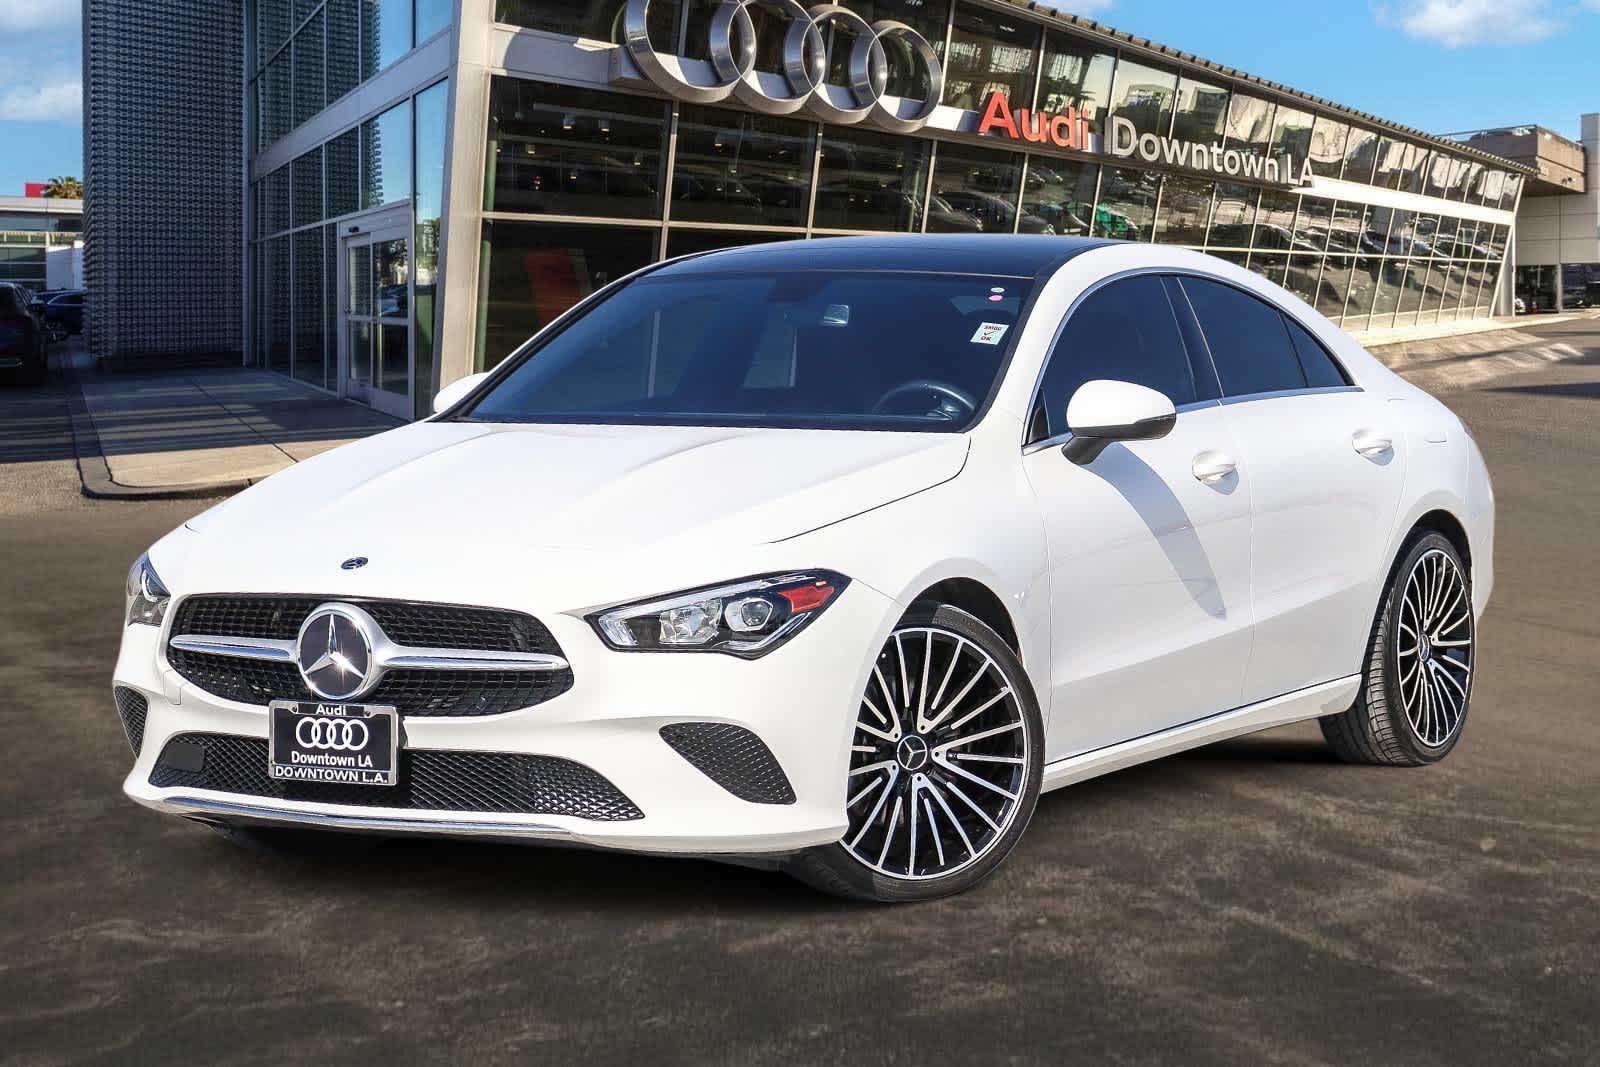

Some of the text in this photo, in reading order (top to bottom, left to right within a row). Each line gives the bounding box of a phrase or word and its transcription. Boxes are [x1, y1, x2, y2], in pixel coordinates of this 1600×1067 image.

[978, 90, 1315, 188] Audi Downtown LA
[315, 703, 346, 716] Audi
[291, 750, 373, 768] Downtown LA
[275, 765, 388, 783] DOWNTOWN L.A.
